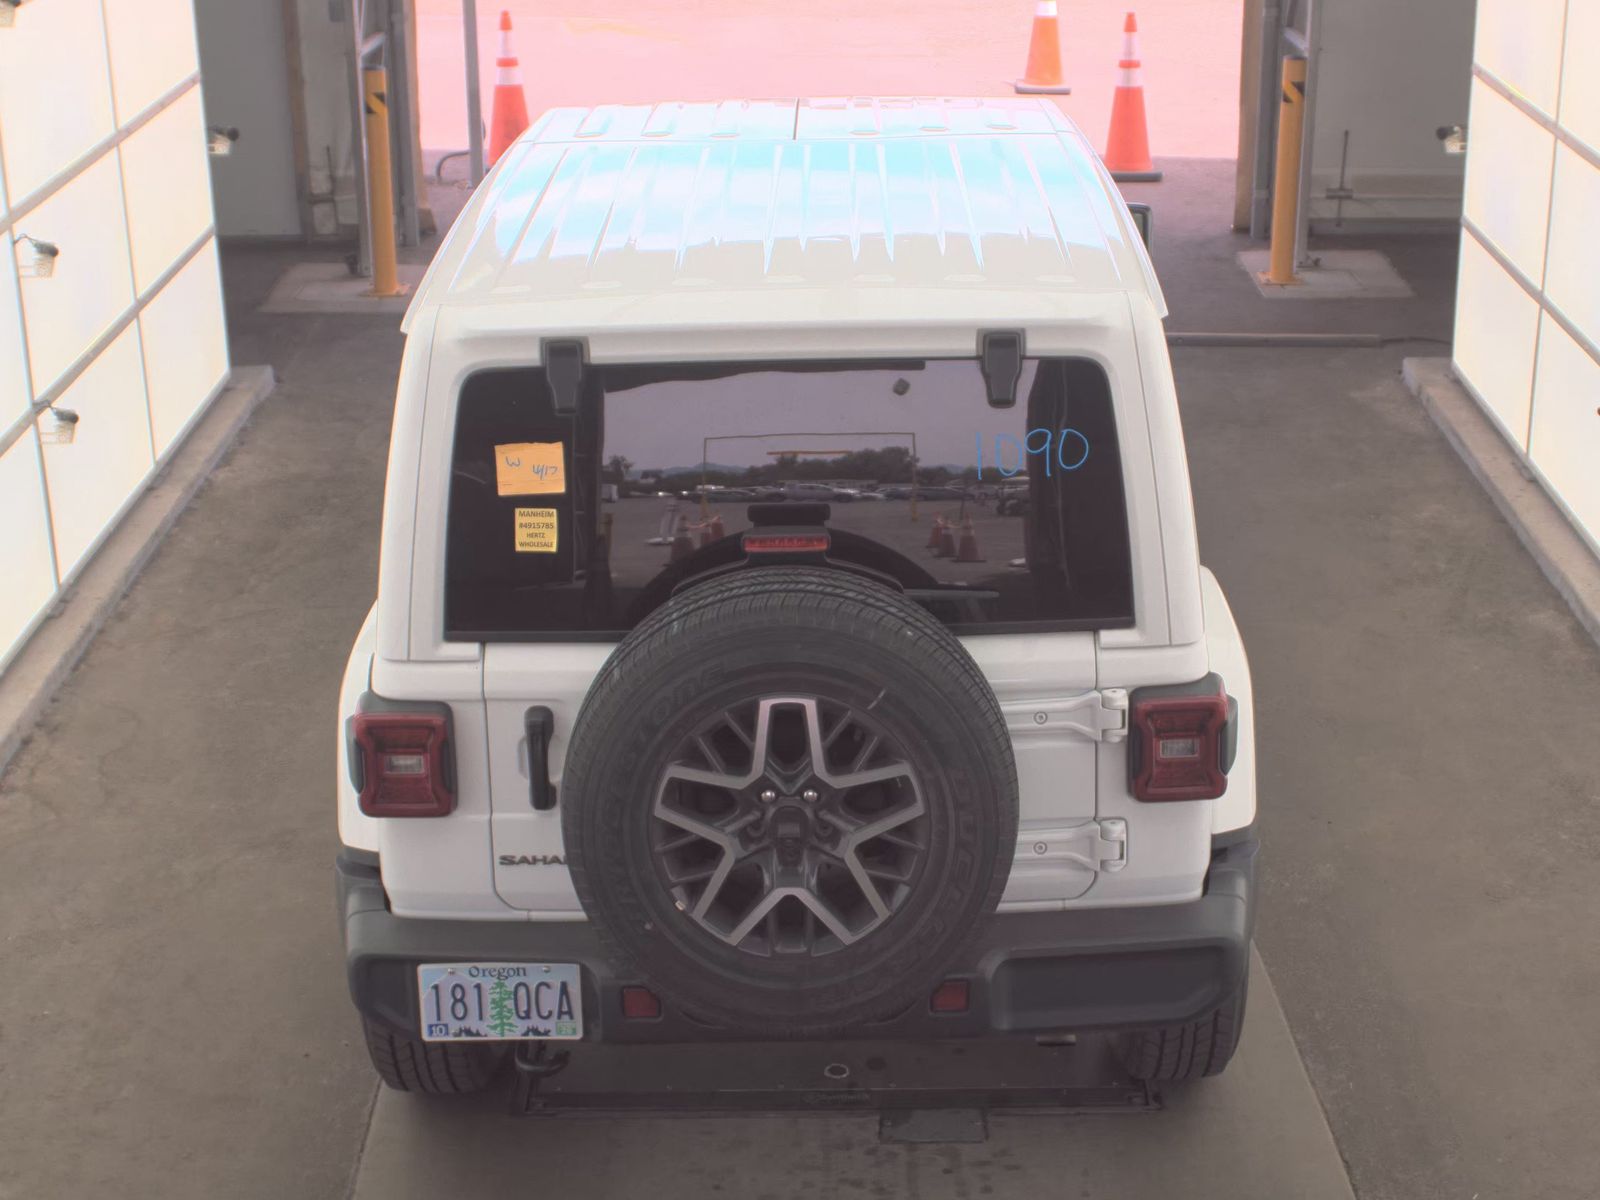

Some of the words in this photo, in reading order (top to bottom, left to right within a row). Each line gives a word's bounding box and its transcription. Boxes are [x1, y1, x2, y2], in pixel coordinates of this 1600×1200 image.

[976, 428, 1089, 480] 1090
[519, 510, 554, 519] MANHEIM
[519, 540, 554, 549] WHOLESALE
[468, 966, 527, 980] Oregon
[431, 983, 483, 1021] 181
[513, 981, 574, 1020] QCA
